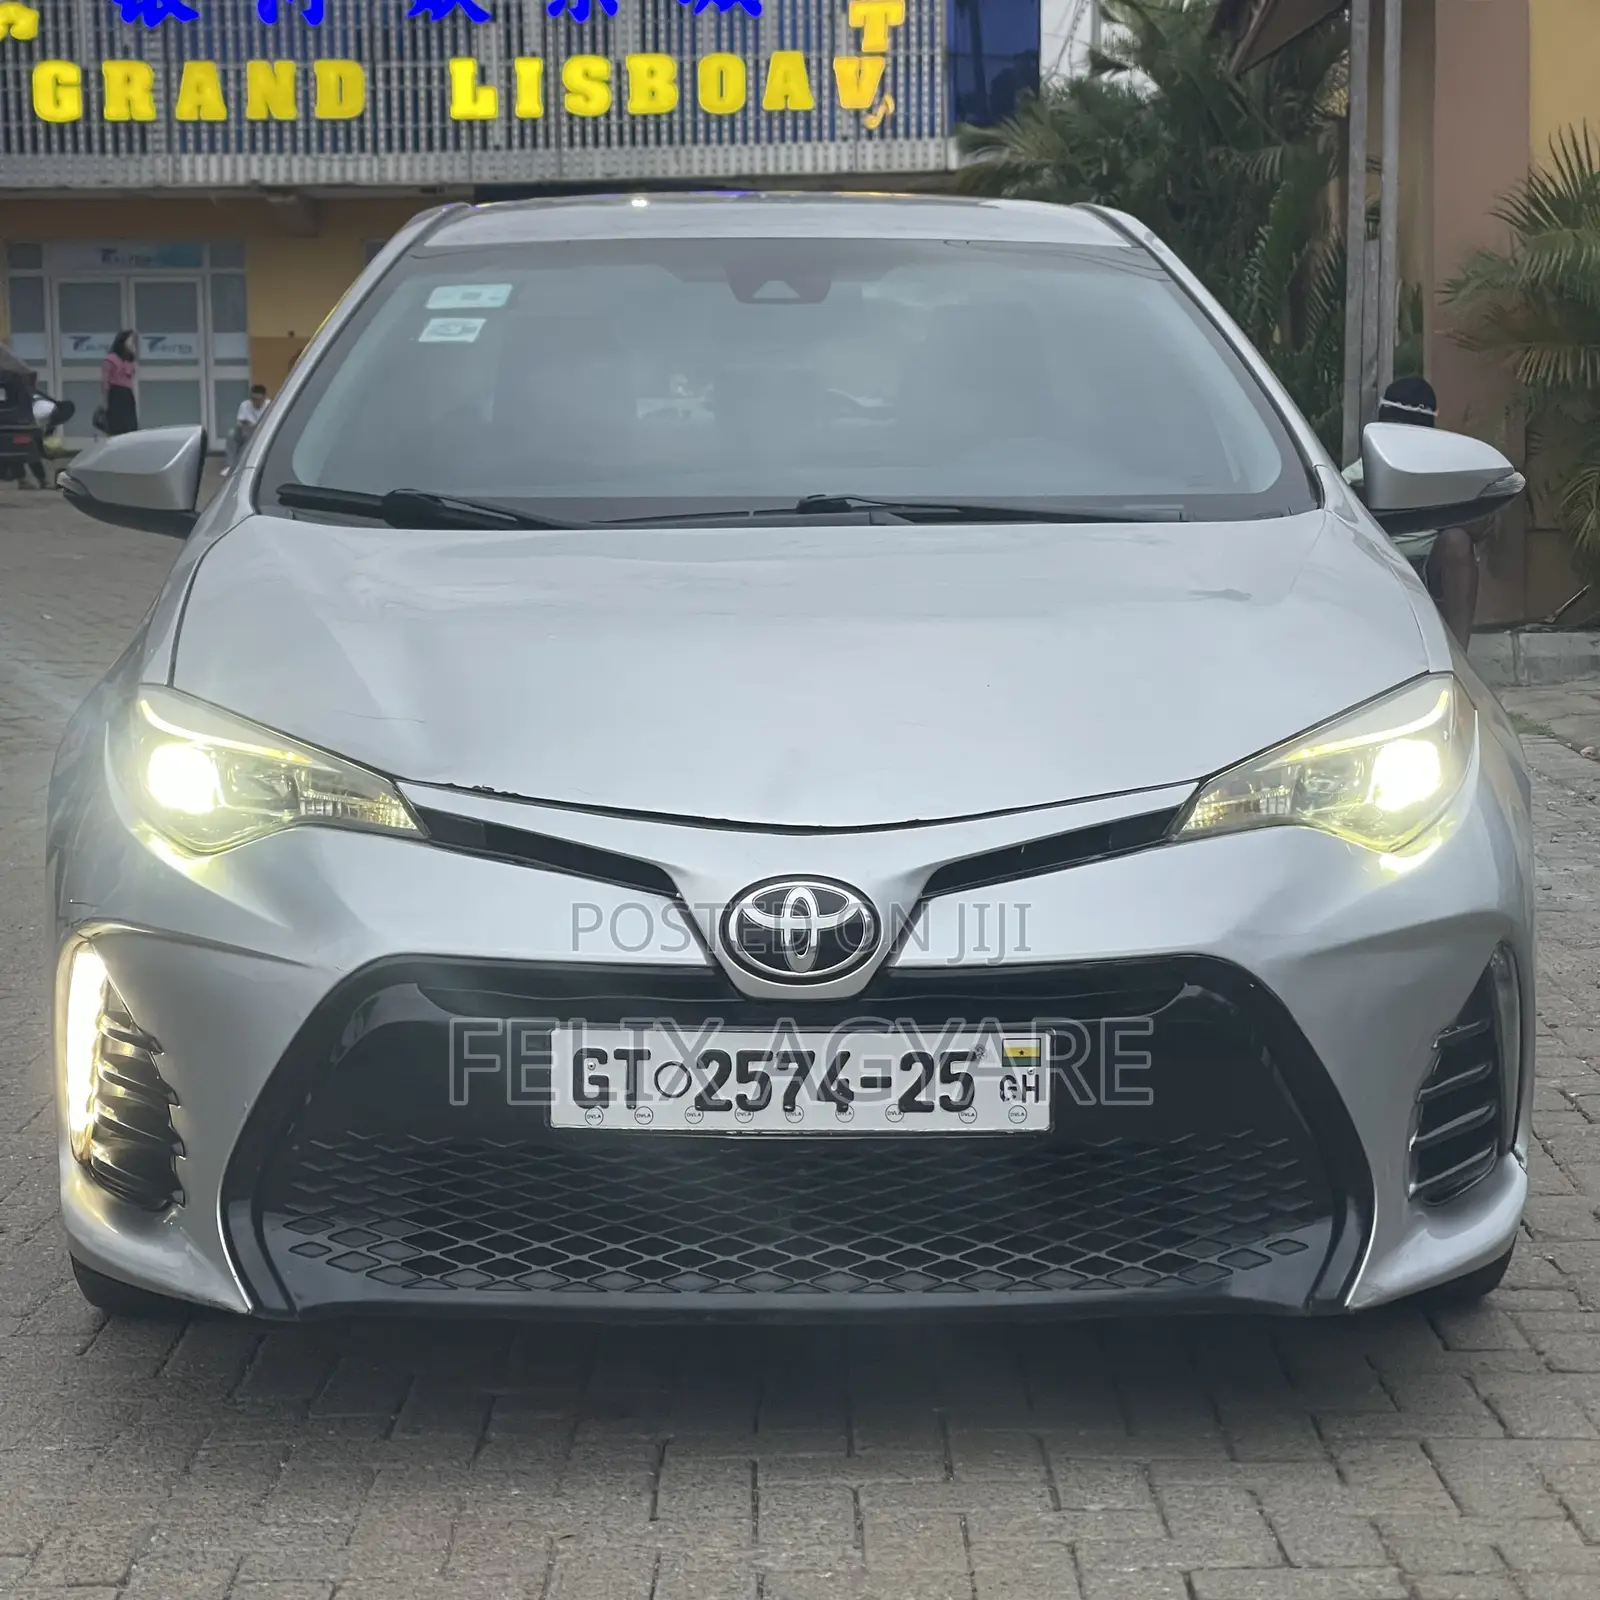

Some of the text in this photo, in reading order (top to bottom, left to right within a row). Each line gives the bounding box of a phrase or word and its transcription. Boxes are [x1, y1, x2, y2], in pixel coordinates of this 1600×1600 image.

[32, 51, 815, 122] GRAND LISBOA
[572, 1048, 651, 1109] GT
[999, 1074, 1040, 1104] GH
